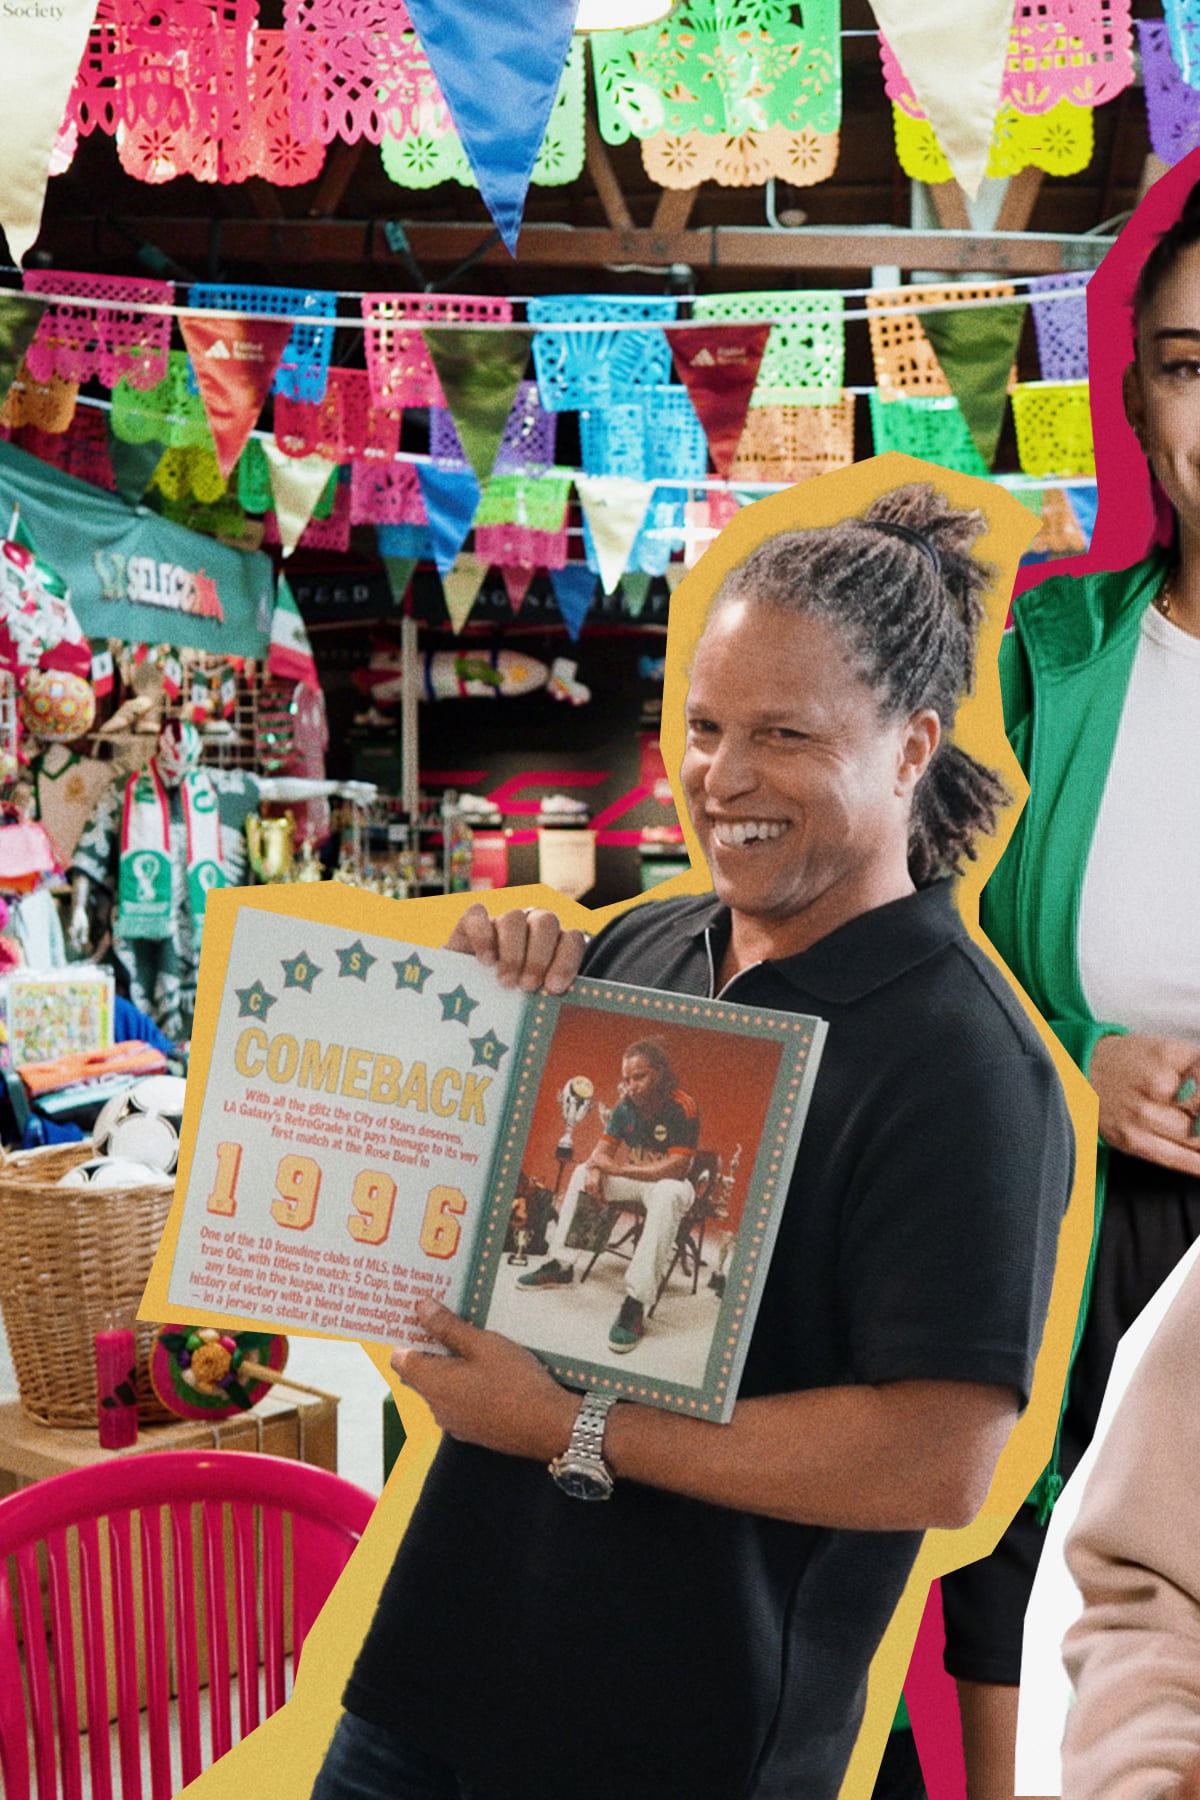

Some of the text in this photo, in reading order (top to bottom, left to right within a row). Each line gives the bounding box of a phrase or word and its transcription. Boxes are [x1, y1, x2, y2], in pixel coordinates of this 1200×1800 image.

[3, 2, 64, 21] Society
[249, 952, 495, 1060] COSMIC
[234, 1026, 494, 1126] COMEBACK
[223, 1100, 237, 1114] LA
[284, 1111, 344, 1135] RetroGrade
[345, 1125, 361, 1139] Kit
[363, 1130, 387, 1145] pays
[388, 1134, 430, 1154] homage
[431, 1143, 443, 1155] to
[444, 1145, 458, 1159] its
[460, 1151, 480, 1167] very
[245, 1088, 270, 1105] With
[272, 1095, 286, 1108] all
[288, 1097, 305, 1112] the
[308, 1102, 331, 1117] glitz
[334, 1107, 351, 1121] the
[354, 1110, 374, 1129] City
[375, 1116, 388, 1129] of
[390, 1118, 416, 1134] Stars
[271, 1125, 430, 1169] first match at the Rose Bowl in
[206, 1140, 468, 1260] 1996
[200, 1225, 221, 1241] One
[223, 1231, 236, 1243] of
[237, 1233, 256, 1248] the
[259, 1237, 273, 1250] 10
[275, 1240, 321, 1262] founding
[322, 1250, 350, 1266] clubs
[353, 1256, 364, 1269] of
[392, 1263, 408, 1277] the
[410, 1267, 434, 1283] team
[445, 1276, 453, 1287] a
[201, 1243, 224, 1257] true
[247, 1253, 271, 1266] with
[273, 1256, 301, 1272] titles
[302, 1263, 314, 1274] to
[355, 1272, 362, 1284] 5
[392, 1280, 409, 1293] the
[410, 1285, 435, 1298] most
[189, 1271, 227, 1292] history
[229, 1280, 242, 1292] of
[243, 1283, 278, 1302] victory
[280, 1291, 303, 1304] with
[305, 1295, 312, 1306] a
[314, 1296, 343, 1312] blend
[344, 1302, 356, 1314] of
[356, 1306, 401, 1325] nostalgia
[204, 1261, 225, 1275] any
[227, 1263, 254, 1279] team
[256, 1270, 267, 1281] in
[269, 1271, 287, 1285] the
[347, 1286, 370, 1300] time
[372, 1292, 382, 1304] to
[384, 1294, 413, 1310] honor
[216, 1295, 224, 1305] a
[225, 1294, 259, 1315] jersey
[261, 1303, 273, 1314] so
[276, 1305, 309, 1320] stellar
[311, 1310, 319, 1324] it
[321, 1315, 339, 1327] got
[340, 1316, 385, 1335] launched
[386, 1325, 405, 1339] into
